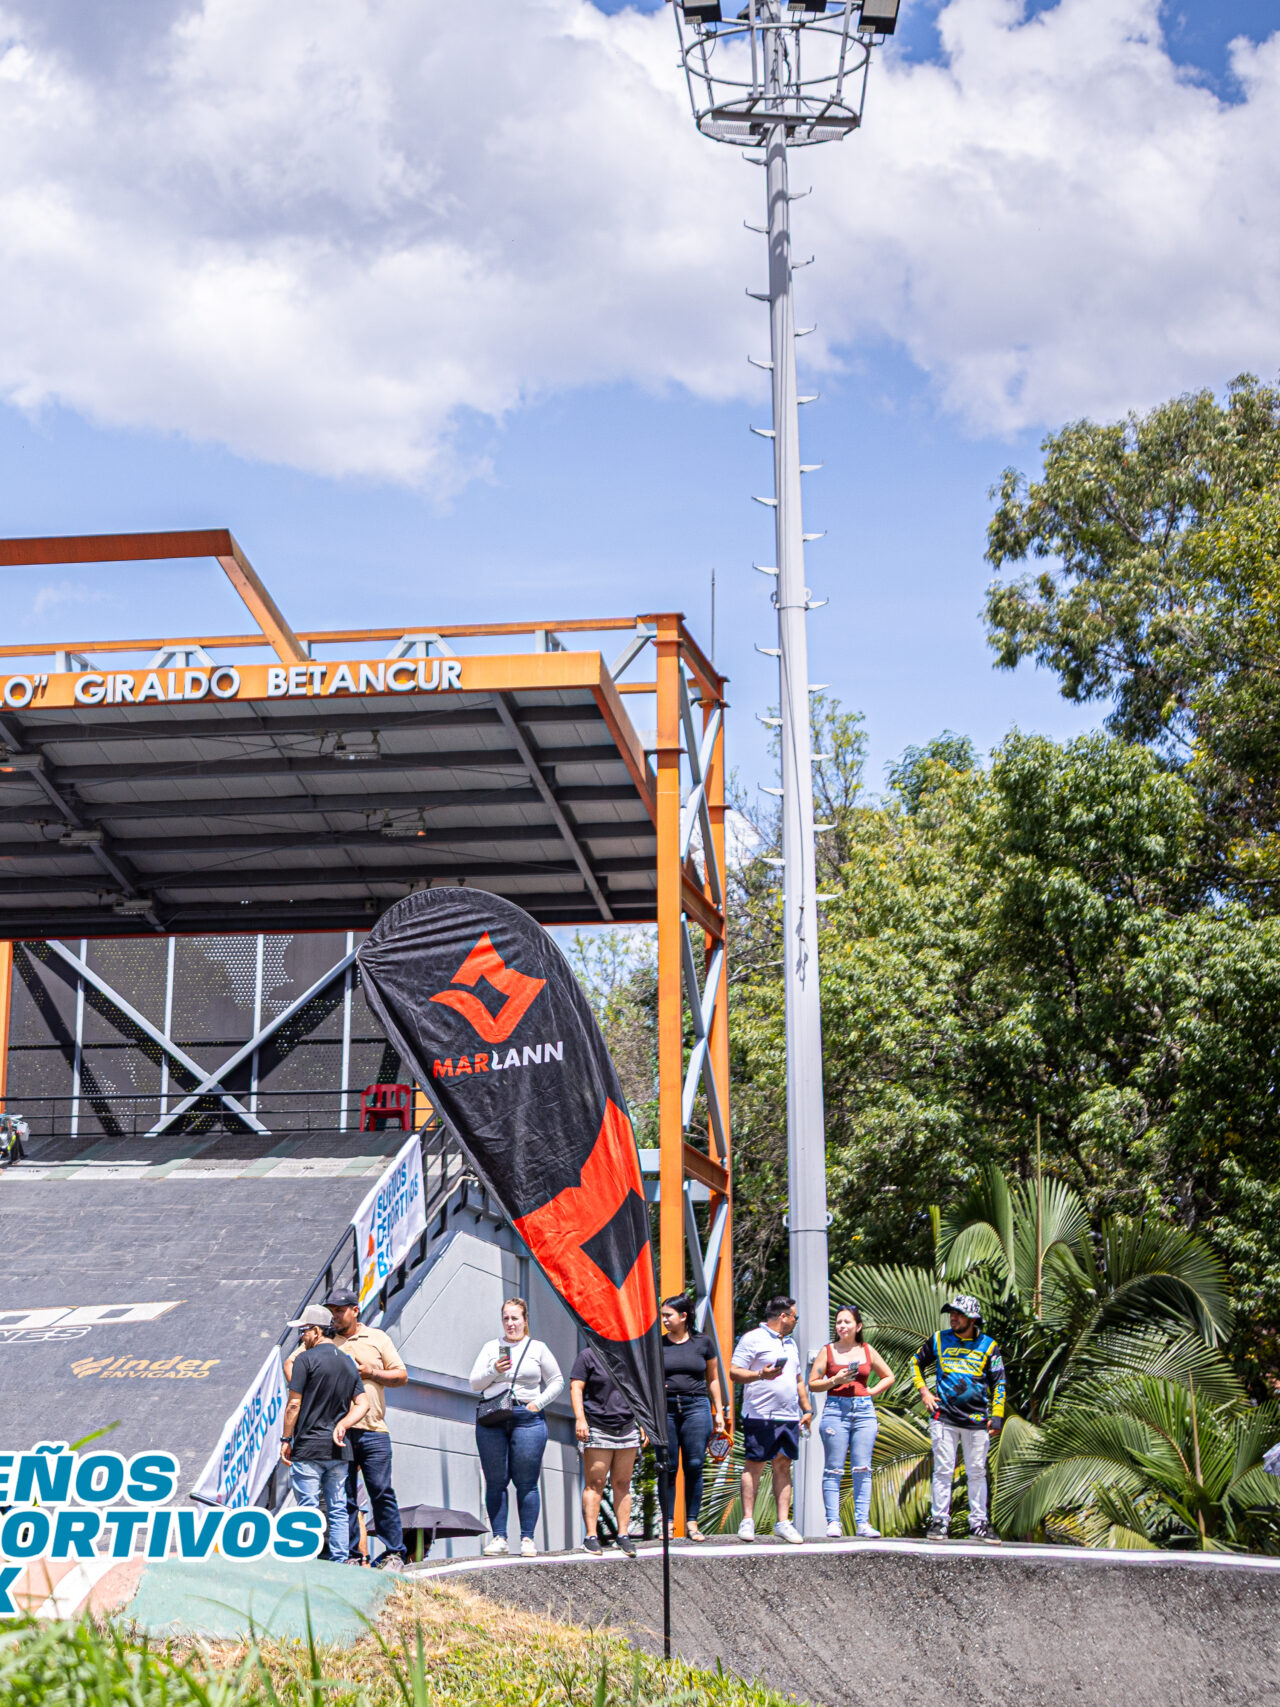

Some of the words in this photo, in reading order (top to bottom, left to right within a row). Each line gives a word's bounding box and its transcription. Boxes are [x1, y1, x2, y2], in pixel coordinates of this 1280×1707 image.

[73, 665, 241, 705] GIRALDO
[267, 660, 464, 698] BETANCUR
[433, 1041, 564, 1079] MARLANN
[98, 1370, 210, 1379] ENVIGADO
